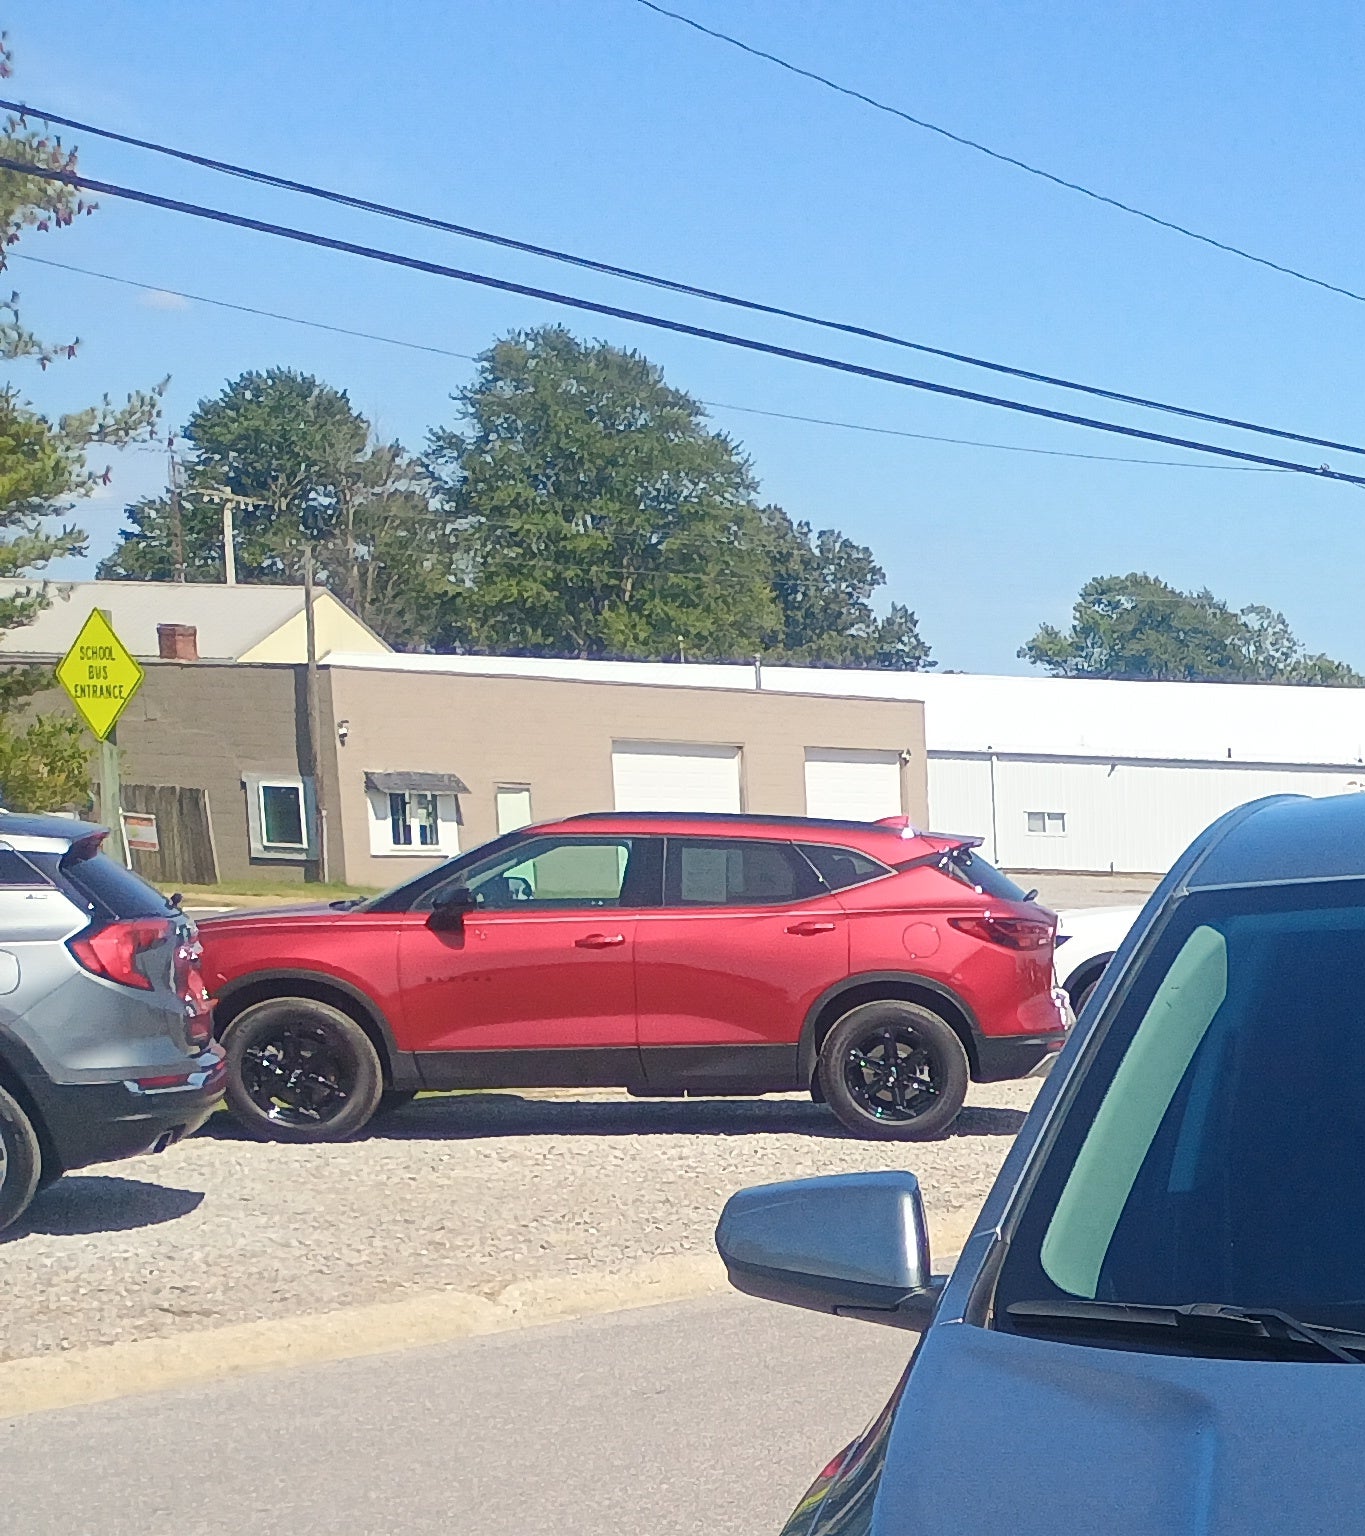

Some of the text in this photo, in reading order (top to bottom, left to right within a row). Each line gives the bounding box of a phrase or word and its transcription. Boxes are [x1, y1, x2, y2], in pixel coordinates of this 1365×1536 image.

[79, 645, 116, 661] SCHOOL
[88, 665, 108, 680] BUS
[74, 683, 125, 699] ENTRANCE
